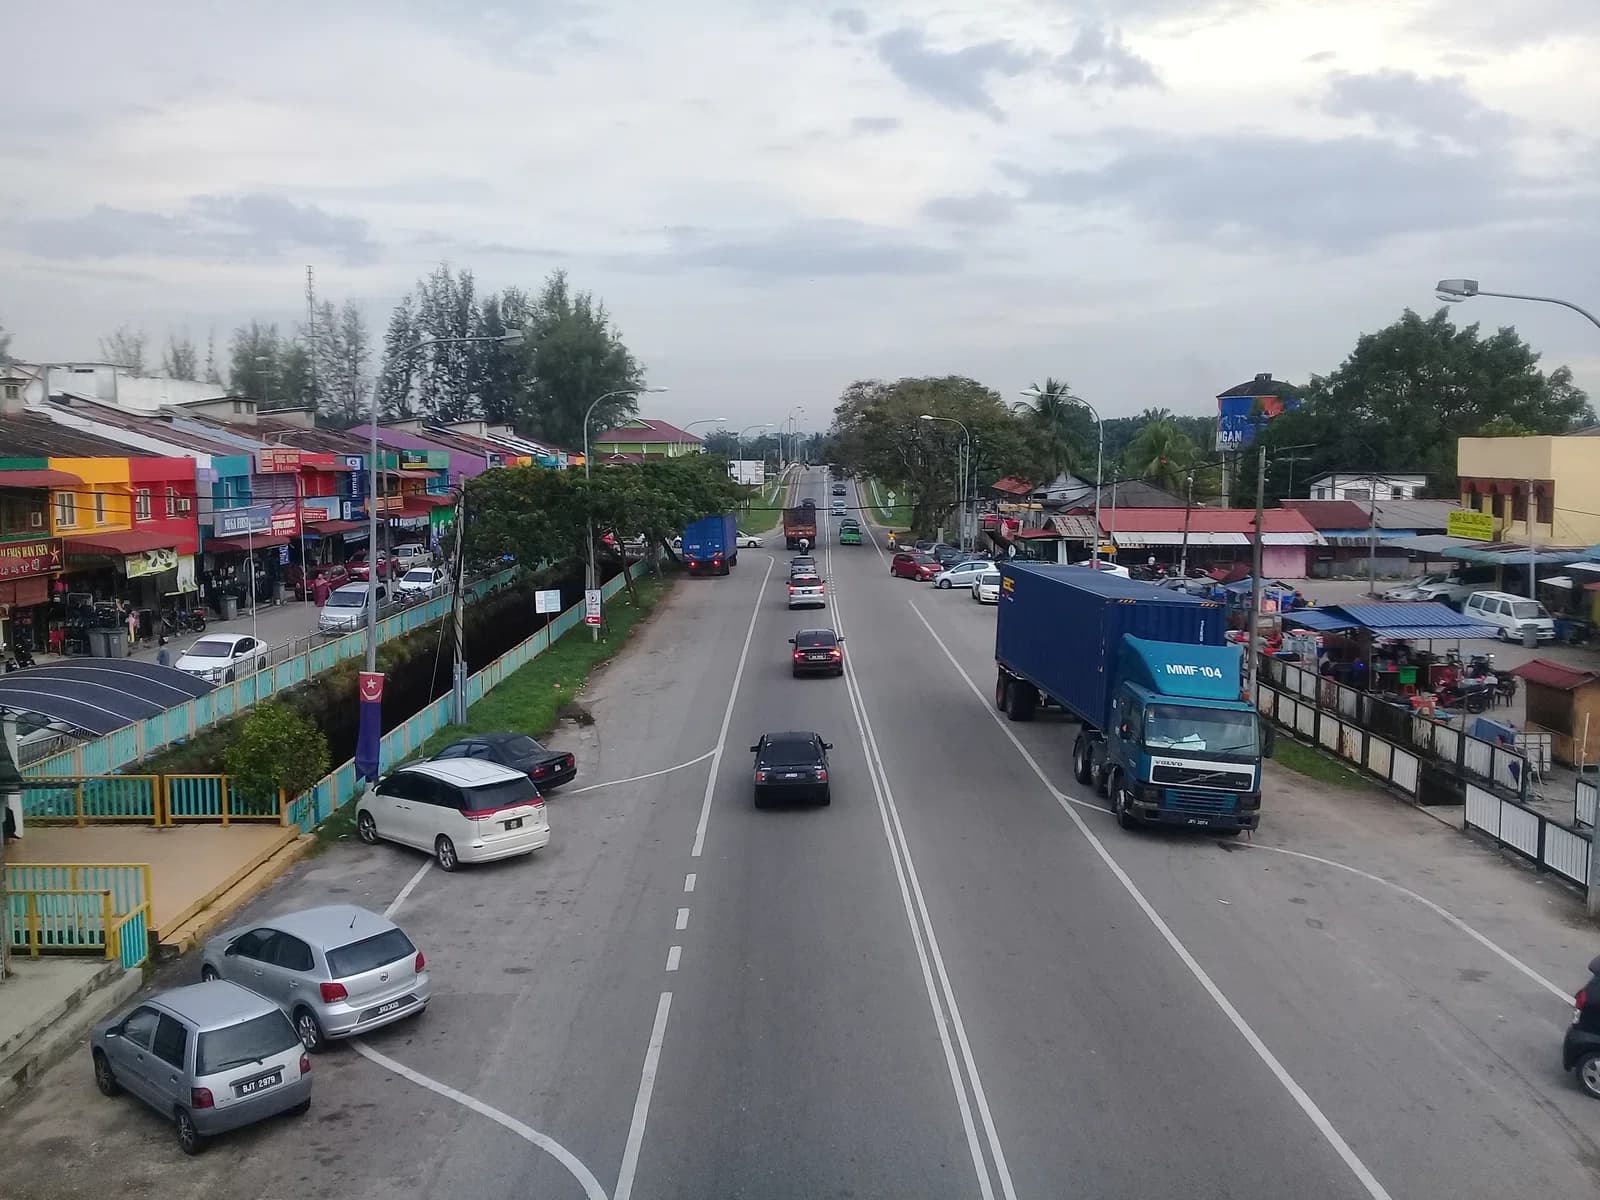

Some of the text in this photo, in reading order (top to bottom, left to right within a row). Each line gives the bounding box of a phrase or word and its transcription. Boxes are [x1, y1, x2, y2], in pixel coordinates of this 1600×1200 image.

[1166, 664, 1223, 679] MMF 104
[242, 1075, 276, 1093] BJT 2979
